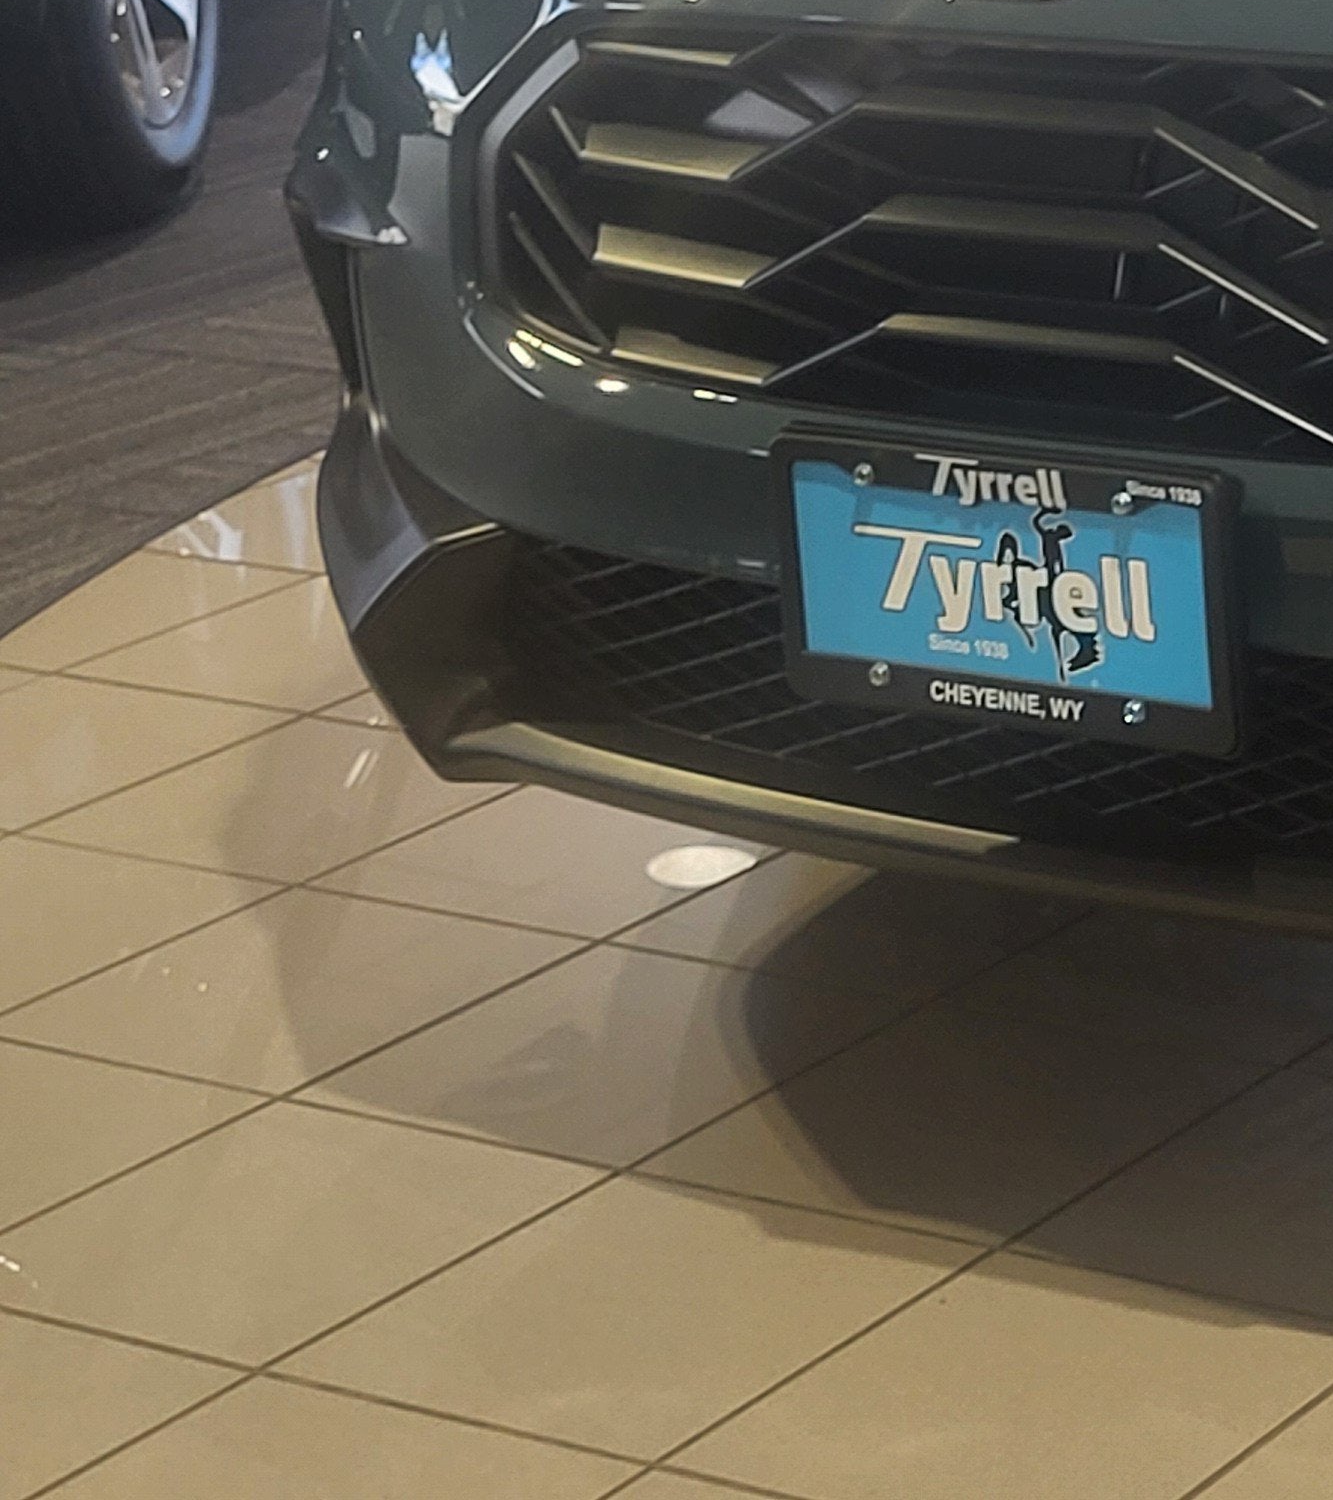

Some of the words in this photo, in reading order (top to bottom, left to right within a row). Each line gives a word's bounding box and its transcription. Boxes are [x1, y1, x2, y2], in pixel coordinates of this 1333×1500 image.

[914, 453, 1067, 510] Tyrrell
[853, 523, 1156, 642] Tyrrell
[929, 679, 1047, 720] CHEYENNE,
[1050, 696, 1085, 722] WY
